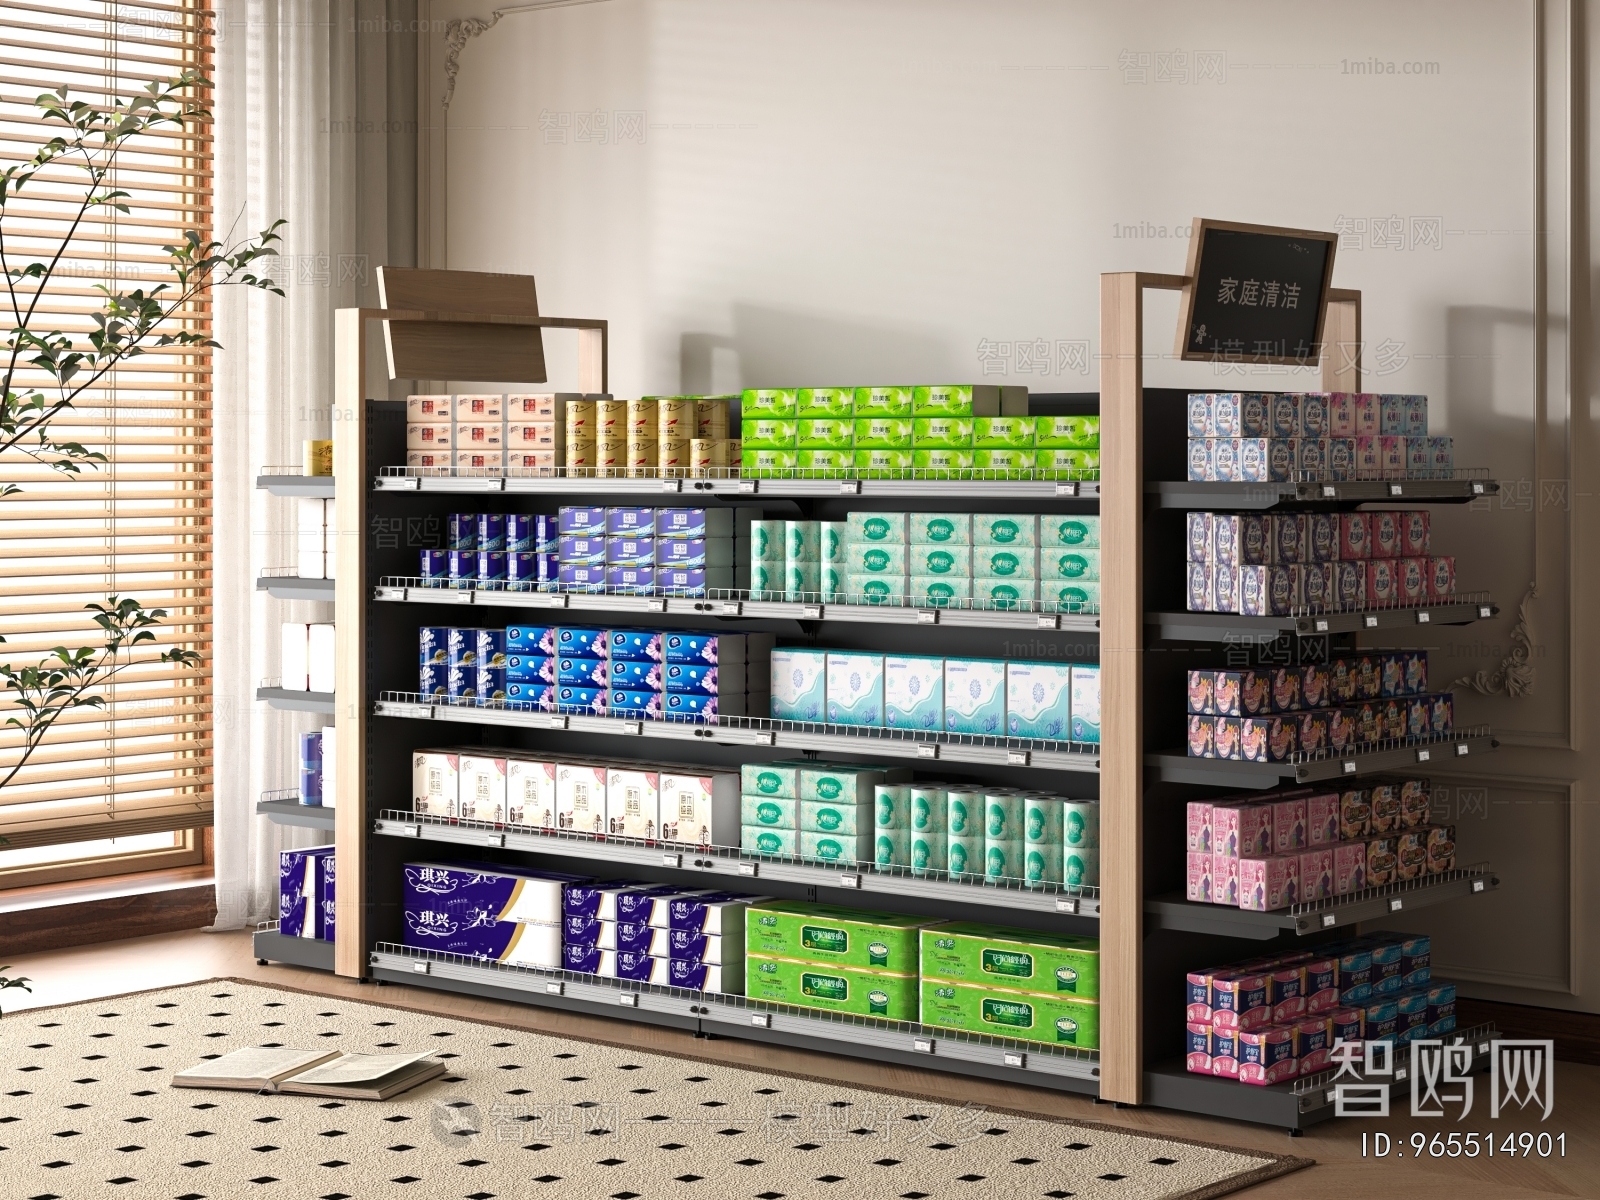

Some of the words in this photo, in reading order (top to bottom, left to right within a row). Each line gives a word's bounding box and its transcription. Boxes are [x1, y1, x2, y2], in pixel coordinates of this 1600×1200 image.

[1217, 276, 1301, 309] 家庭清洁
[419, 868, 450, 884] 琪兴
[419, 910, 450, 928] 琪兴
